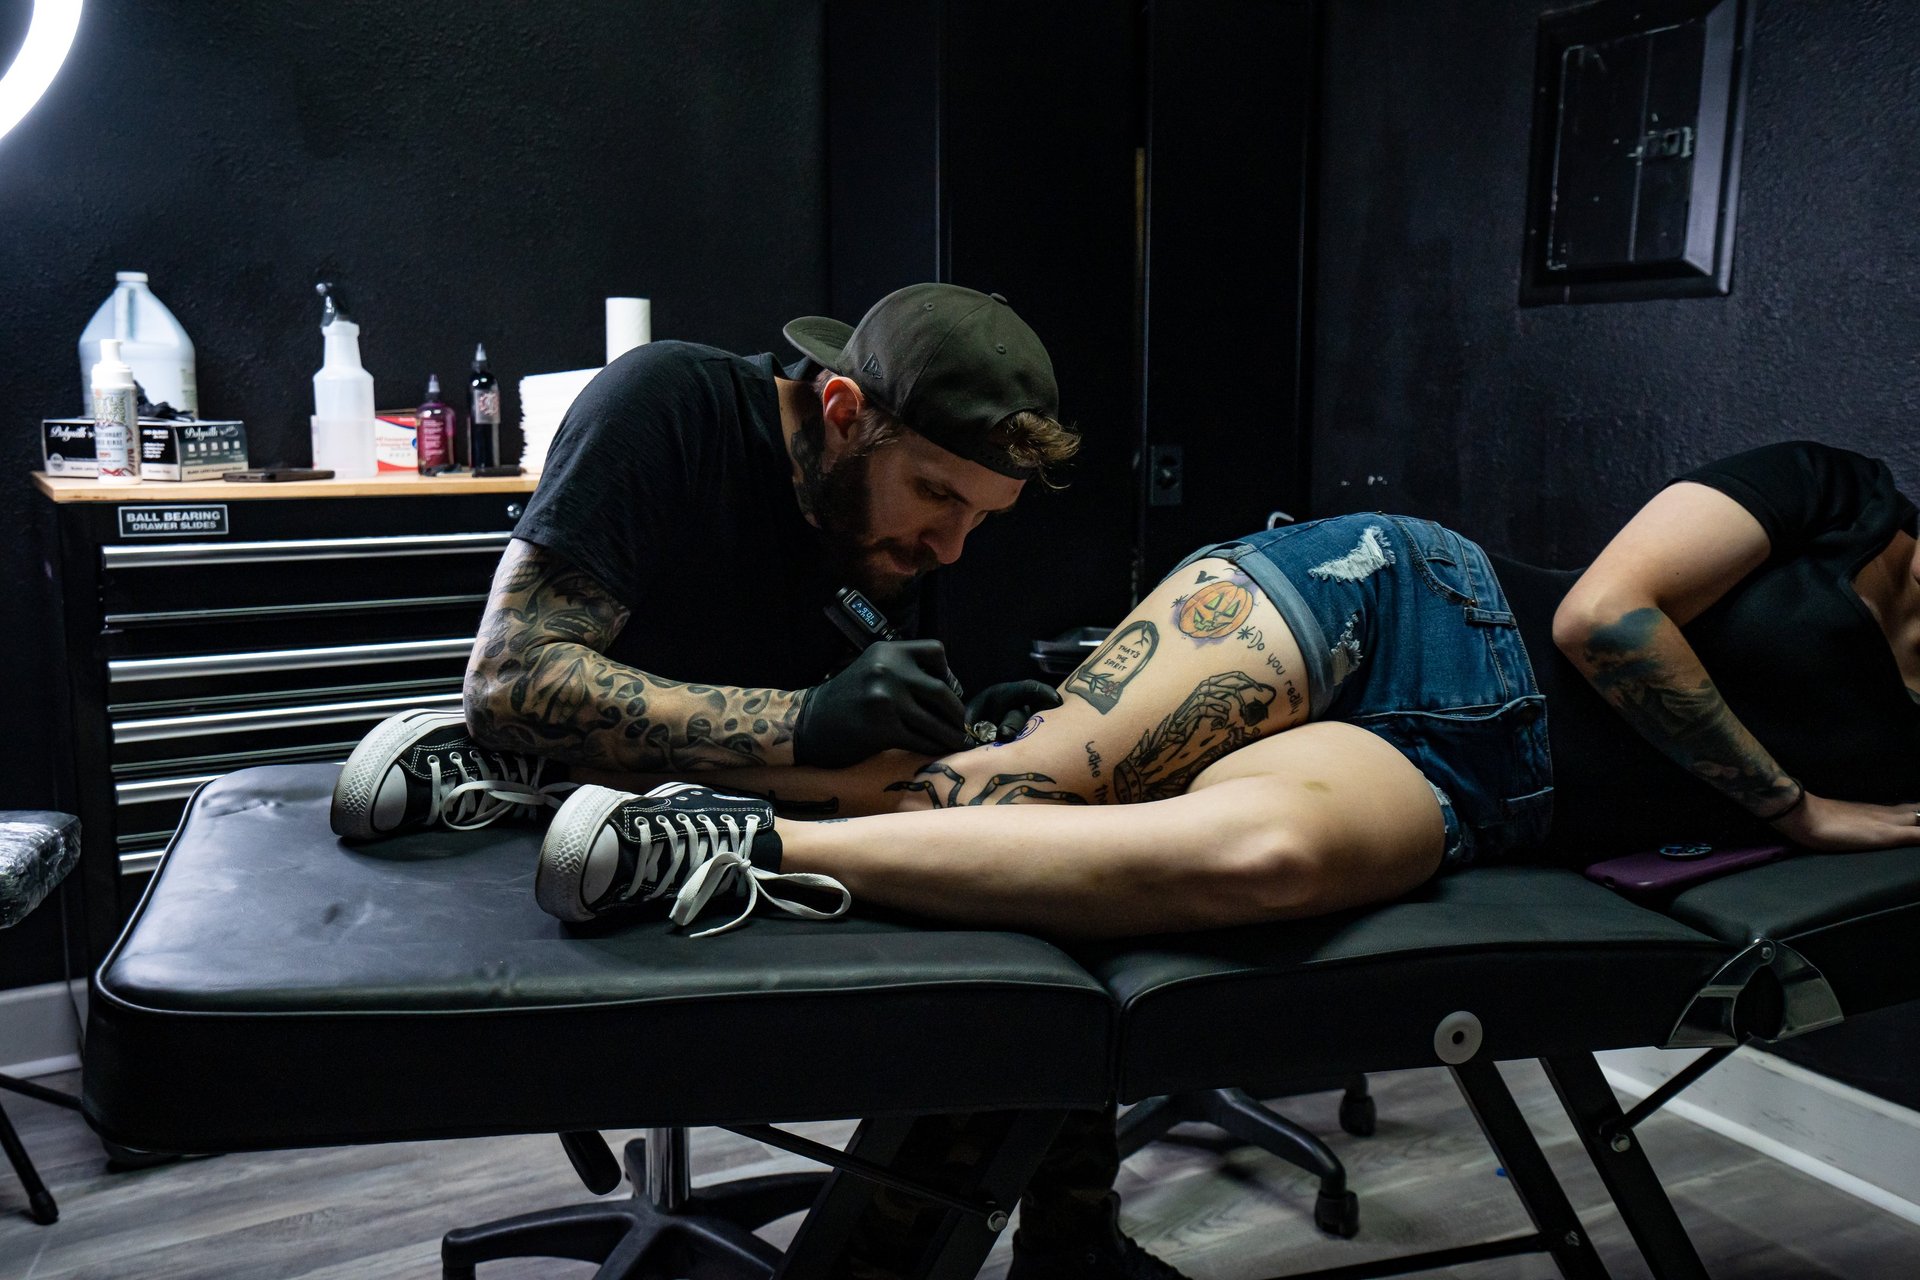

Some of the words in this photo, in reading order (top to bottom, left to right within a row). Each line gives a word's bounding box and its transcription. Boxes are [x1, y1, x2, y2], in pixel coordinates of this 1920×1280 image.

[126, 512, 160, 522] BALL
[163, 511, 221, 522] BEARING
[132, 522, 178, 531] DRAWER
[180, 520, 217, 530] SLIDES
[1118, 644, 1141, 659] THAT'S
[1104, 658, 1128, 671] SPIRIT
[1116, 653, 1129, 664] THE
[1247, 630, 1265, 651] Do
[1266, 653, 1286, 675] you
[1284, 680, 1304, 716] really
[1085, 740, 1102, 778] wake
